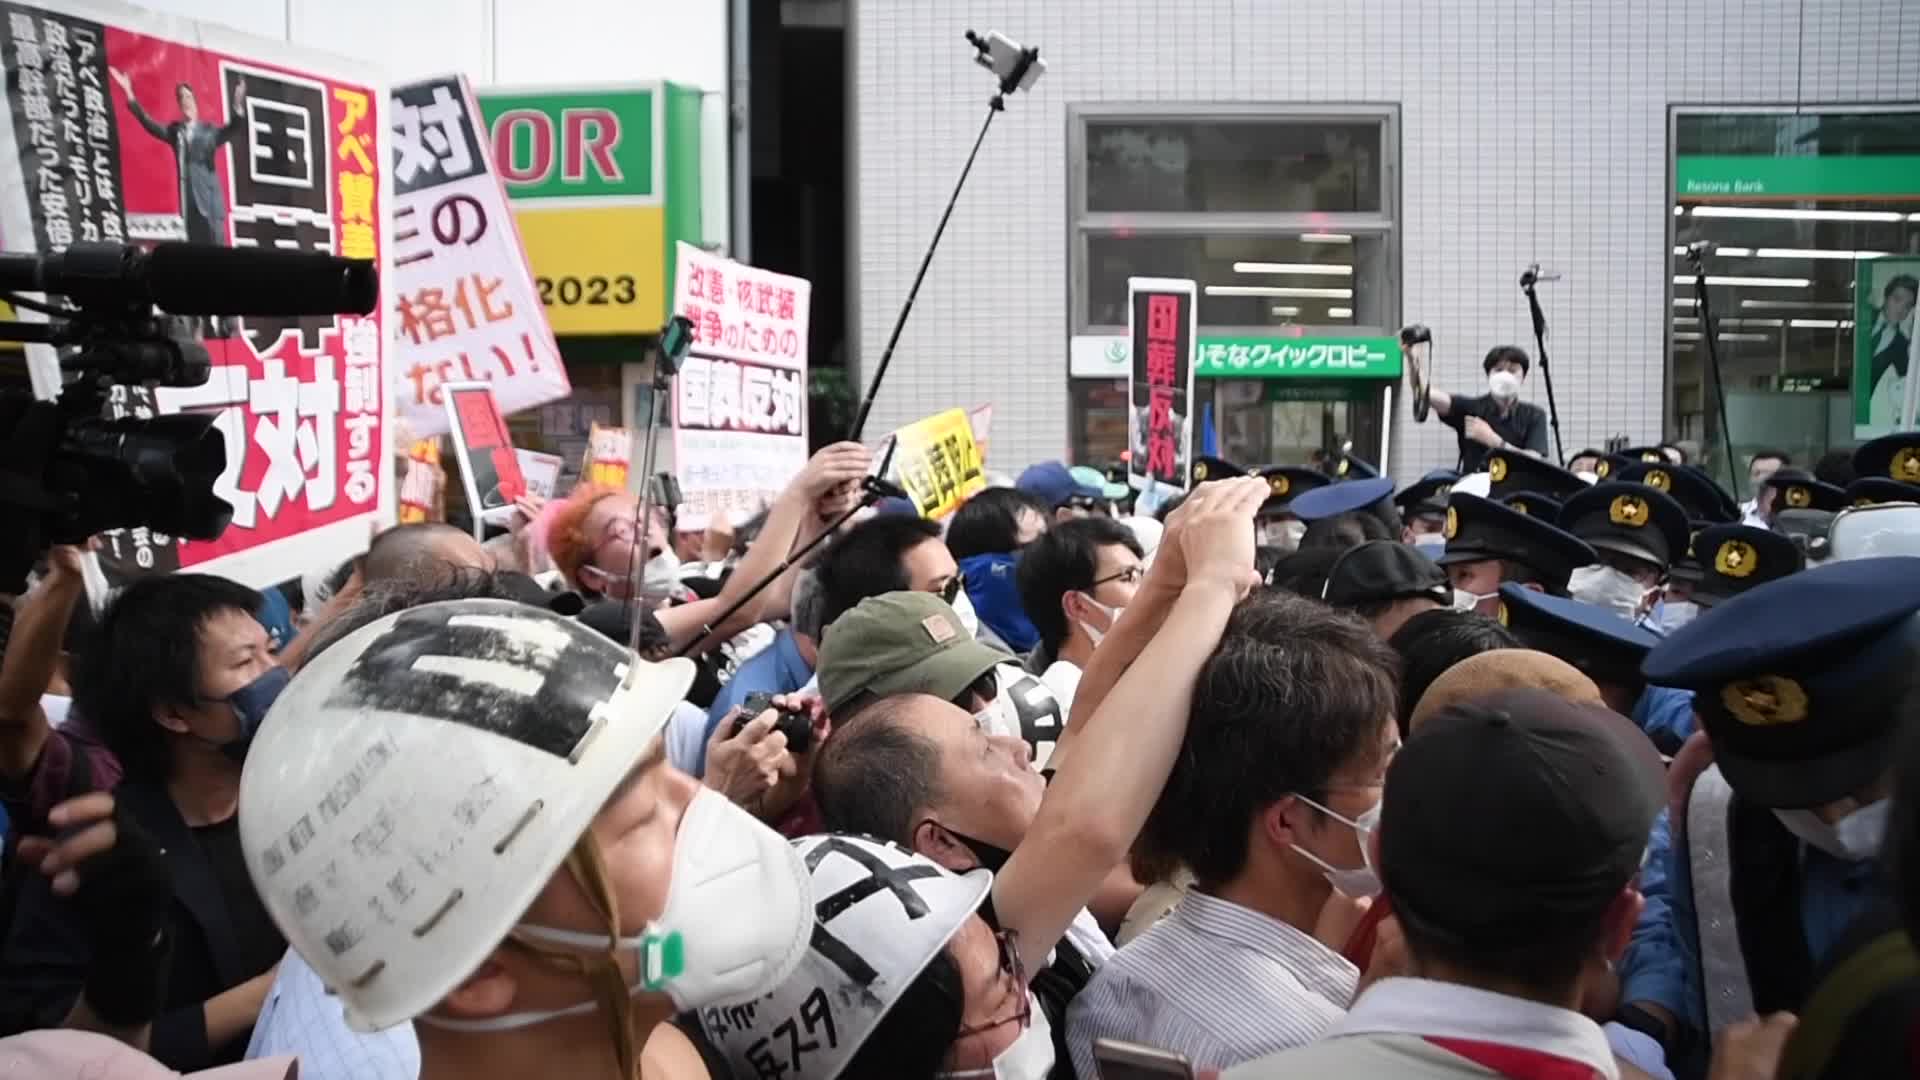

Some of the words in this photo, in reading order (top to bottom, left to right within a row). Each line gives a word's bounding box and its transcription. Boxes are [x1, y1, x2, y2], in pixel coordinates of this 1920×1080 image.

[8, 12, 74, 253] 最高幹部だった安倍
[492, 107, 624, 187] OR
[1687, 179, 1730, 193] Resona
[1734, 178, 1765, 193] Bank
[685, 303, 800, 358] 戦争のための
[680, 360, 802, 434] 国葬反対
[1144, 294, 1179, 480] 国葬反対
